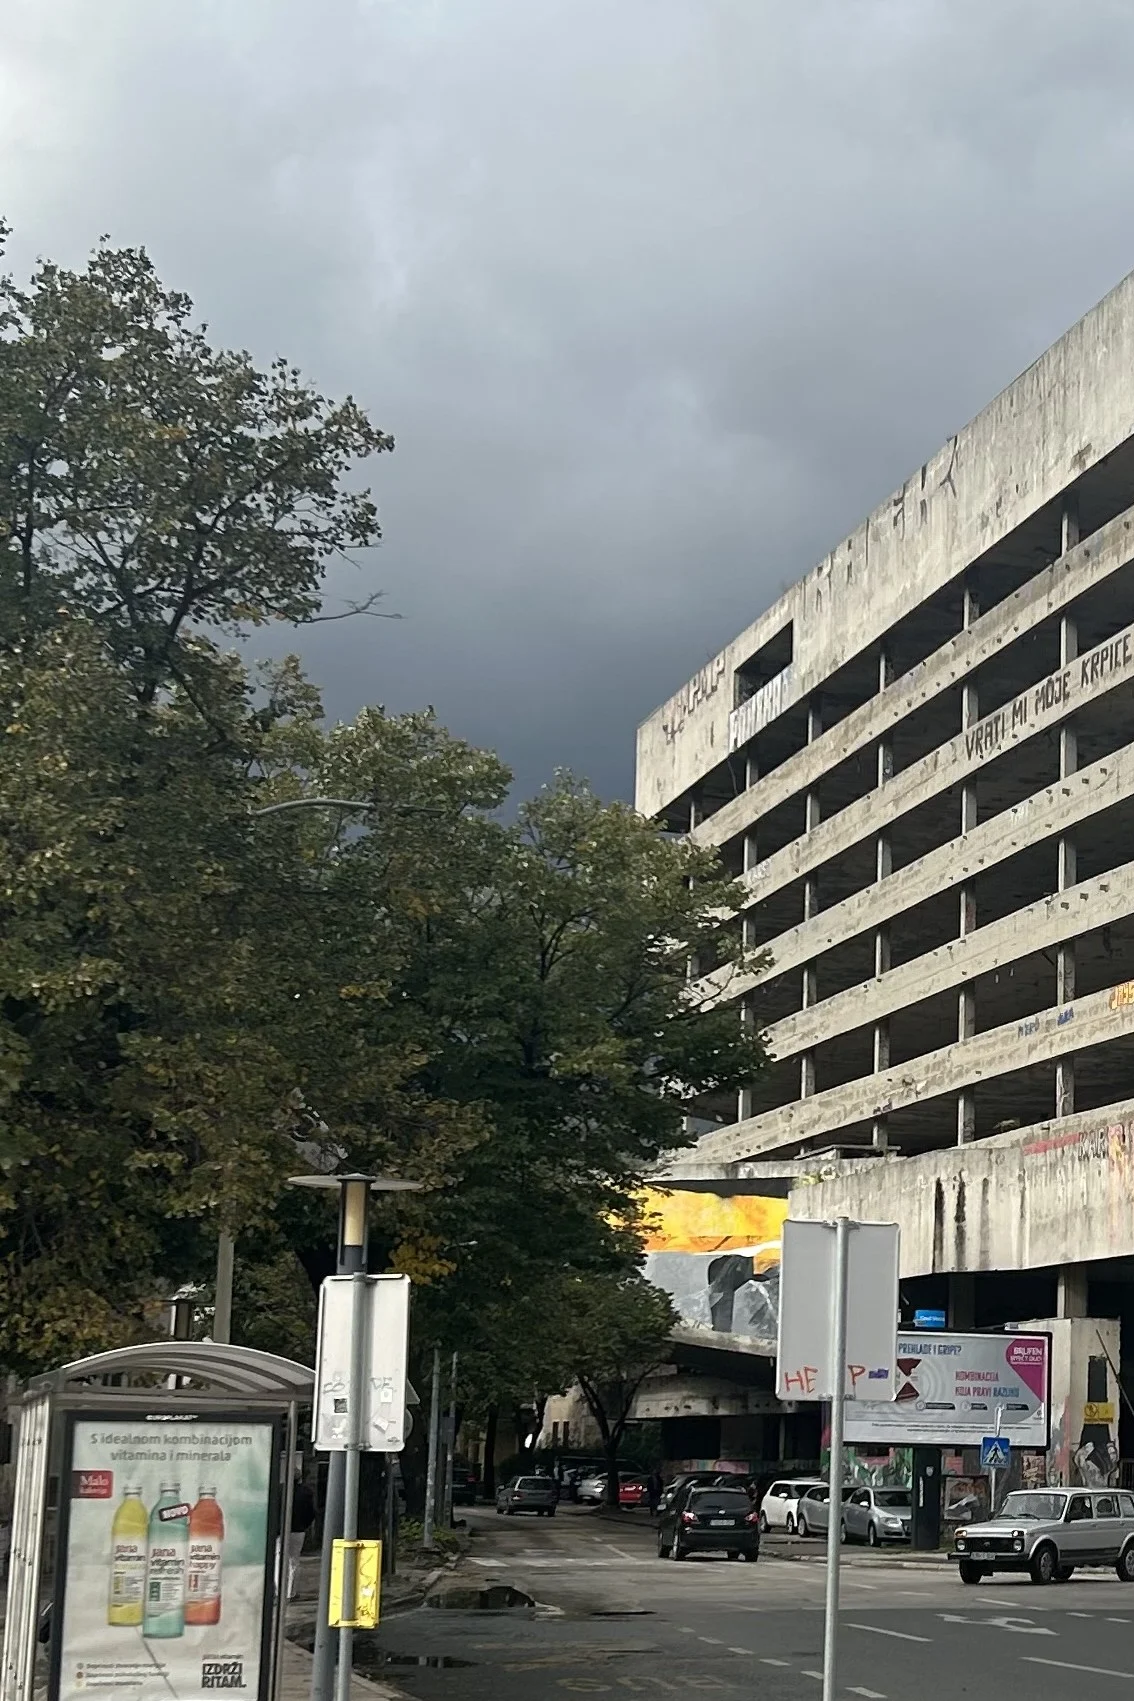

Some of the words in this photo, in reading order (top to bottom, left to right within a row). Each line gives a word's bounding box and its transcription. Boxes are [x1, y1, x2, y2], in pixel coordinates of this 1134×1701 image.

[965, 711, 1005, 761] VRATI
[1011, 696, 1028, 731] MI
[1034, 670, 1071, 716] MOJE
[1080, 633, 1133, 689] KRPICE
[90, 1433, 98, 1445] S
[101, 1433, 161, 1445] idealnom
[164, 1433, 252, 1447] kombinacijom
[111, 1450, 167, 1461] vitamina
[176, 1450, 232, 1461] minerala
[202, 1662, 243, 1675] IZDRŽI
[202, 1675, 247, 1688] RITAM.
